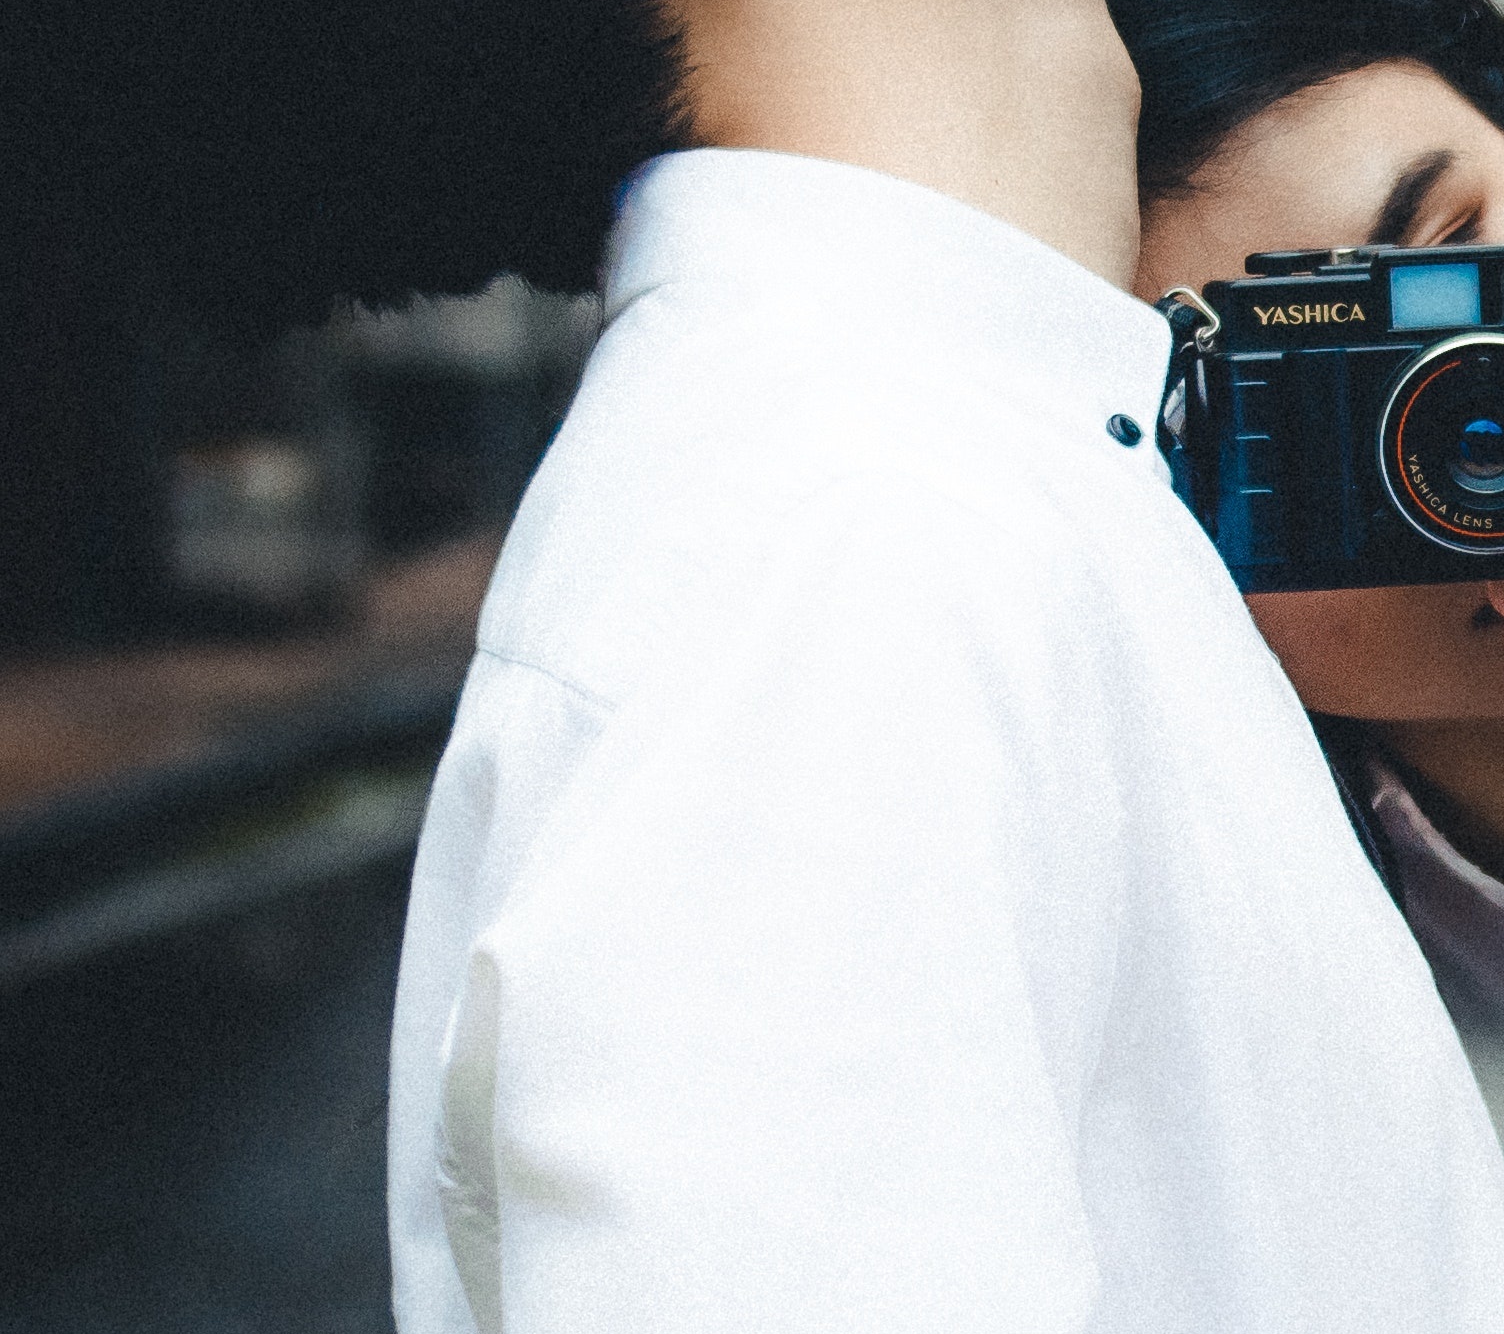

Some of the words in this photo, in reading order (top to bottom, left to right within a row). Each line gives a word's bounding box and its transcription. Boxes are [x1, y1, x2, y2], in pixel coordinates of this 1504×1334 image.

[1253, 302, 1366, 326] YASHICA
[1408, 454, 1448, 515] YASHICA
[1453, 512, 1494, 529] LENS
